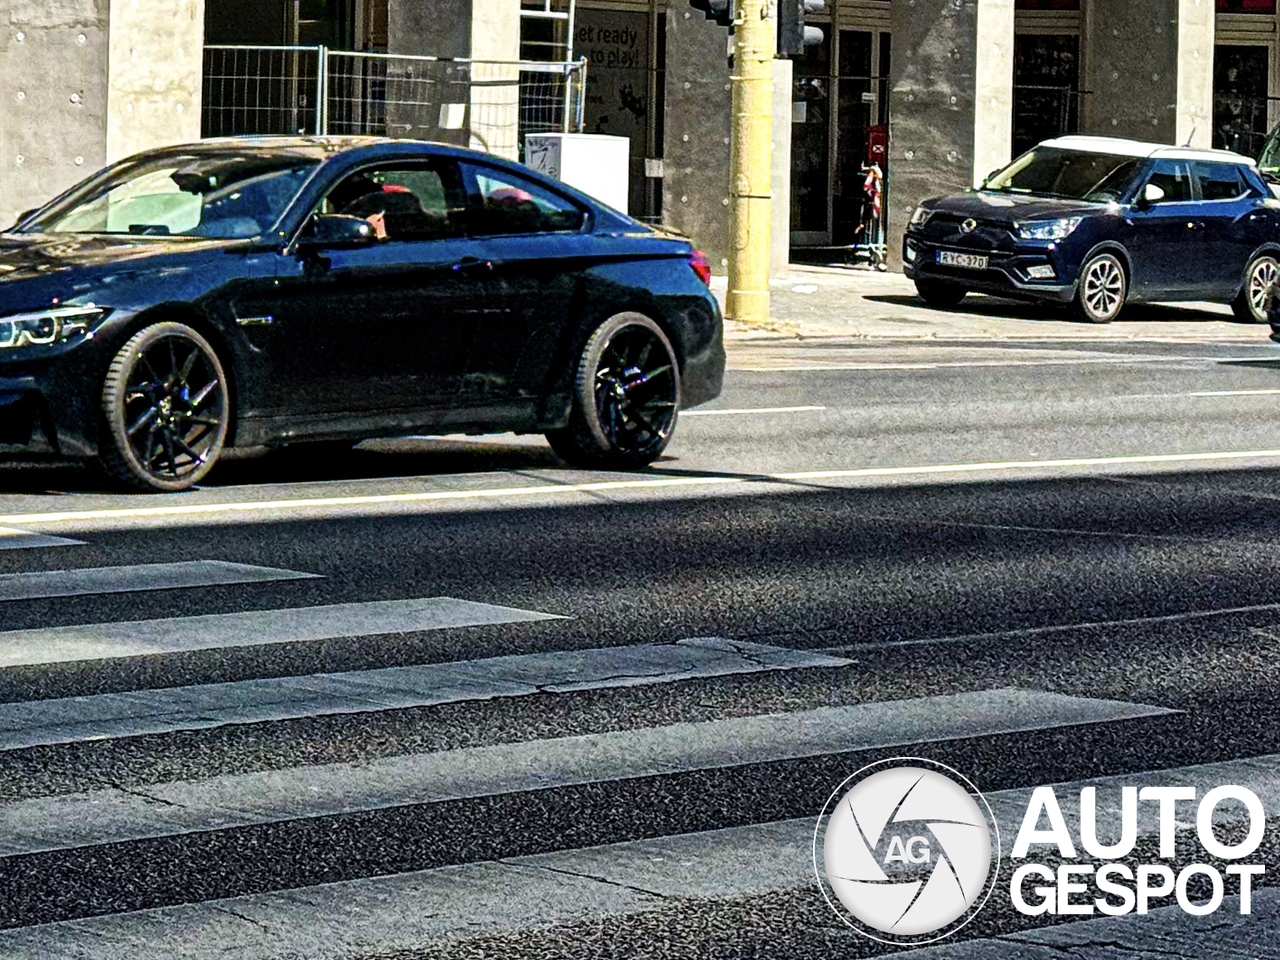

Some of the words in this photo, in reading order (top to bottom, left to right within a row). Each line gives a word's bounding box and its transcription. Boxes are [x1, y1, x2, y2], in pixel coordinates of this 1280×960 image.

[597, 26, 638, 49] ready
[590, 47, 604, 63] to
[607, 48, 640, 68] play!
